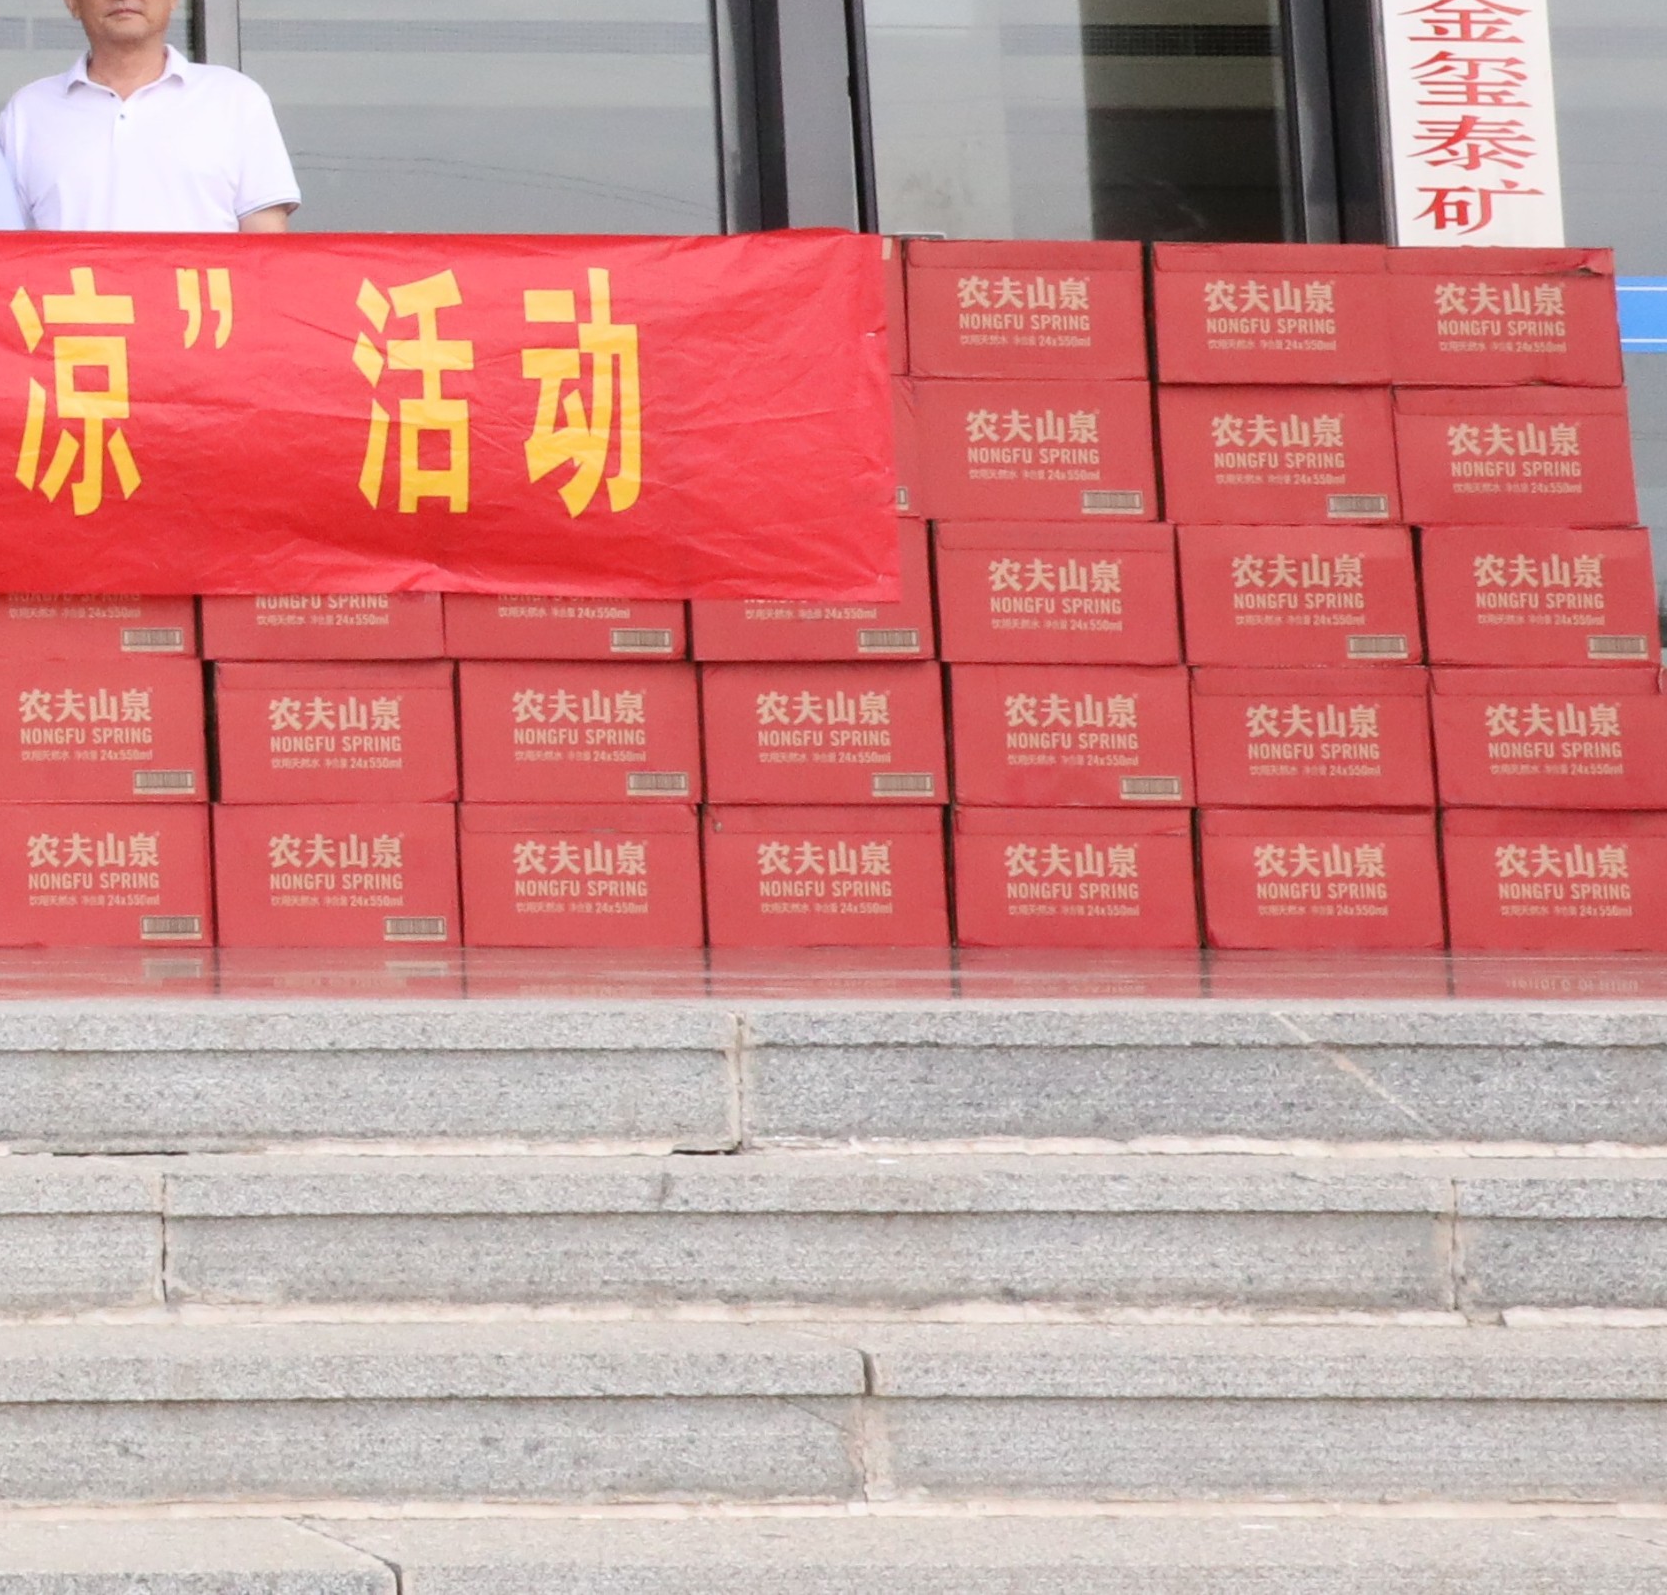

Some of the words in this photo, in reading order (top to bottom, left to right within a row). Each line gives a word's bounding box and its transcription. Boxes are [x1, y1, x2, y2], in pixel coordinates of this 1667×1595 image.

[956, 273, 1091, 312] 农夫山泉
[1202, 279, 1337, 315] 农夫山泉
[1433, 282, 1567, 317] 农夫山泉
[958, 311, 1025, 331] NONGFU
[1030, 312, 1092, 332] SPRING
[1204, 317, 1271, 336] NONGFU
[1276, 317, 1339, 336] SPRING
[352, 266, 642, 520] 活动
[963, 408, 1101, 444] 农夫山泉
[1209, 412, 1346, 449] 农夫山泉
[1445, 421, 1582, 458] 农夫山泉
[966, 446, 1033, 465] NONGFU
[1038, 446, 1101, 465] SPRING
[1212, 451, 1280, 470] NONGFU
[1285, 451, 1347, 470] SPRING
[1450, 460, 1517, 478] NONGFU
[1522, 460, 1583, 478] SPRING
[986, 556, 1123, 595] 农夫山泉
[1230, 552, 1366, 589] 农夫山泉
[1471, 552, 1607, 589] 农夫山泉
[988, 595, 1056, 615] NONGFU
[1061, 596, 1125, 616] SPRING
[1231, 592, 1299, 611] NONGFU
[1304, 592, 1366, 611] SPRING
[1474, 591, 1540, 610] NONGFU
[1545, 591, 1606, 610] SPRING
[17, 687, 154, 724] 农夫山泉
[266, 695, 405, 732] 农夫山泉
[510, 687, 648, 725] 农夫山泉
[753, 689, 892, 726] 农夫山泉
[1003, 692, 1140, 730] 农夫山泉
[1243, 702, 1382, 740] 农夫山泉
[1483, 701, 1623, 738] 农夫山泉
[18, 726, 86, 746] NONGFU
[92, 726, 154, 746] SPRING
[269, 734, 336, 754] NONGFU
[341, 734, 404, 754] SPRING
[512, 727, 579, 746] NONGFU
[585, 727, 648, 746] SPRING
[1005, 731, 1073, 750] NONGFU
[1078, 731, 1140, 750] SPRING
[1246, 742, 1315, 761] NONGFU
[1320, 742, 1383, 761] SPRING
[1487, 741, 1556, 760] NONGFU
[1561, 741, 1624, 760] SPRING
[25, 831, 161, 869] 农夫山泉
[267, 832, 406, 870] 农夫山泉
[511, 839, 650, 876] 农夫山泉
[755, 839, 894, 876] 农夫山泉
[1003, 842, 1141, 879] 农夫山泉
[1250, 841, 1389, 879] 农夫山泉
[1492, 842, 1632, 880] 农夫山泉
[27, 871, 94, 891] NONGFU
[99, 871, 161, 891] SPRING
[268, 872, 336, 891] NONGFU
[342, 872, 404, 891] SPRING
[513, 879, 581, 898] NONGFU
[587, 879, 651, 898] SPRING
[1005, 881, 1073, 901] NONGFU
[1078, 881, 1141, 901] SPRING
[1254, 882, 1322, 901] NONGFU
[1327, 882, 1389, 901] SPRING
[1497, 881, 1565, 901] NONGFU
[1570, 881, 1634, 901] SPRING
